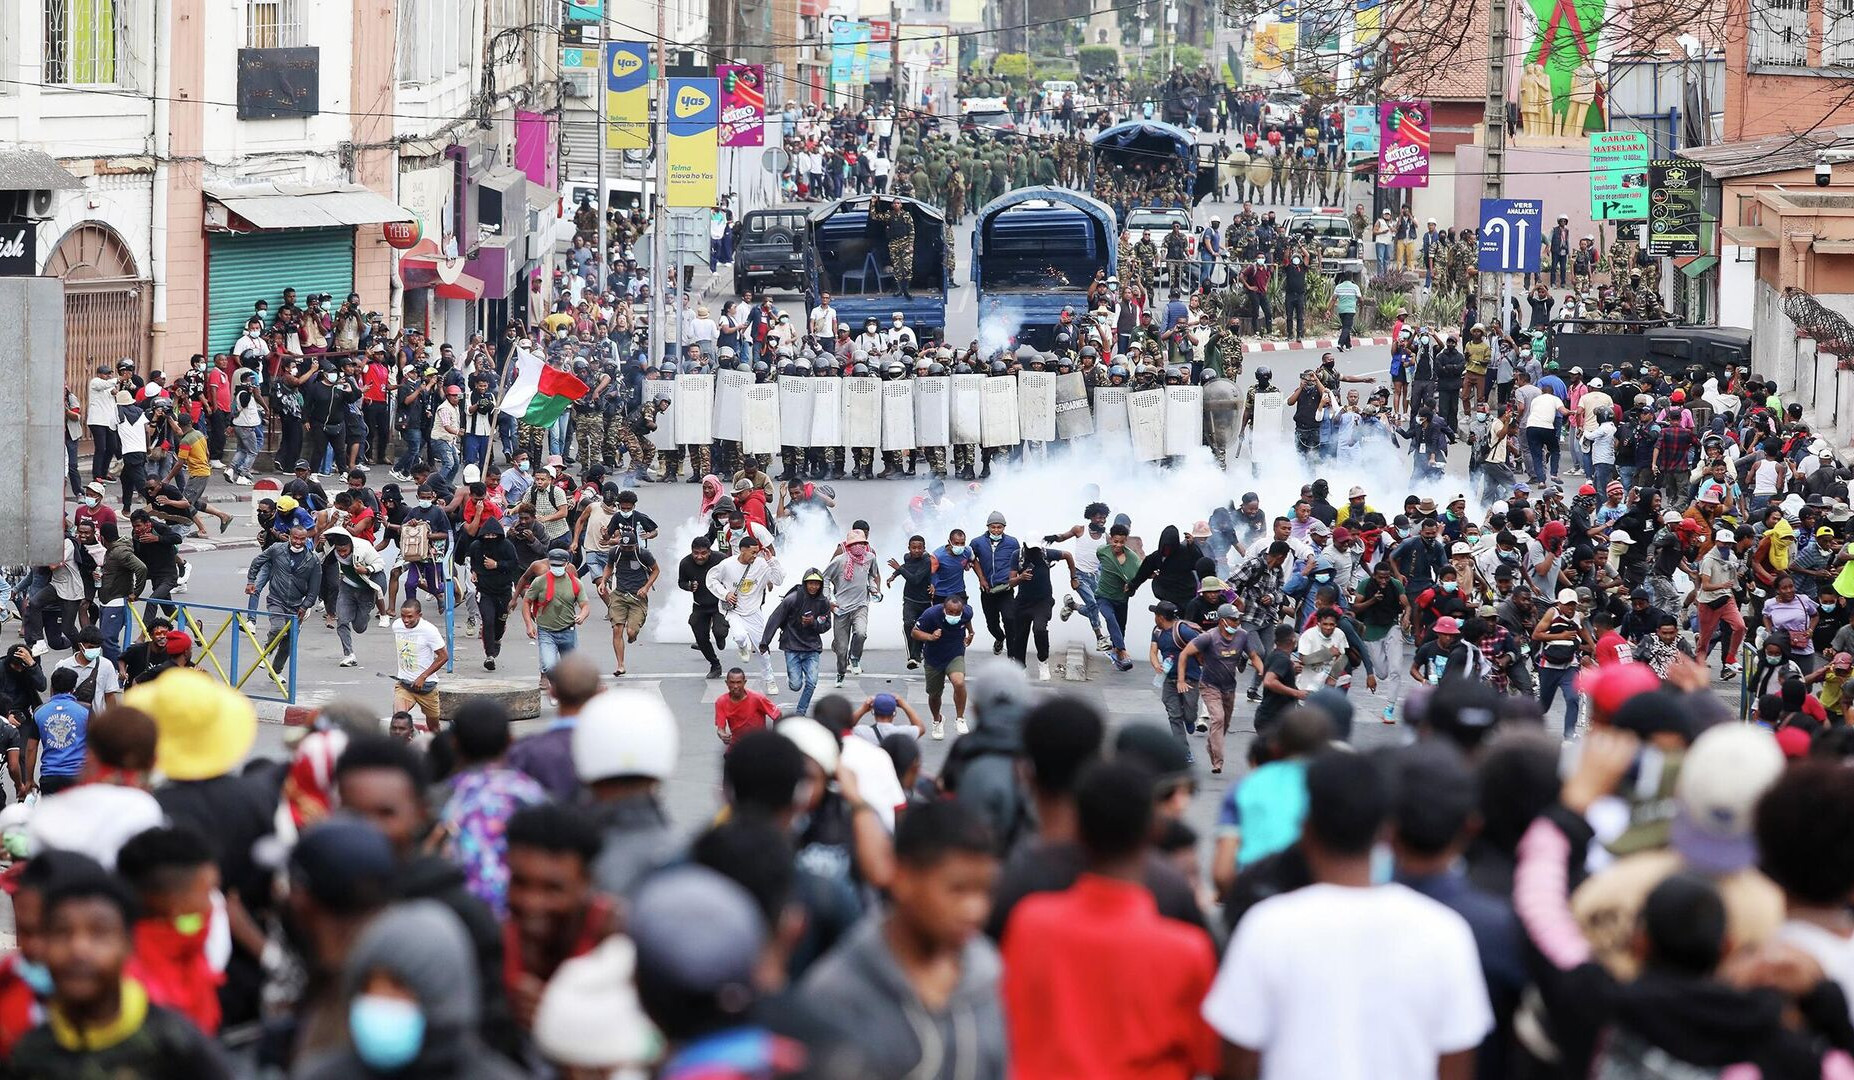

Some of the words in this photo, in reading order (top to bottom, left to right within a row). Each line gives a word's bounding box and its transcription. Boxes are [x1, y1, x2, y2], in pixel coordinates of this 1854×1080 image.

[1601, 134, 1637, 142] GARAGE
[1593, 144, 1645, 153] MATSELAKA
[671, 172, 690, 180] niova
[690, 172, 700, 180] ho
[701, 172, 714, 180] Yas
[387, 225, 410, 238] THB
